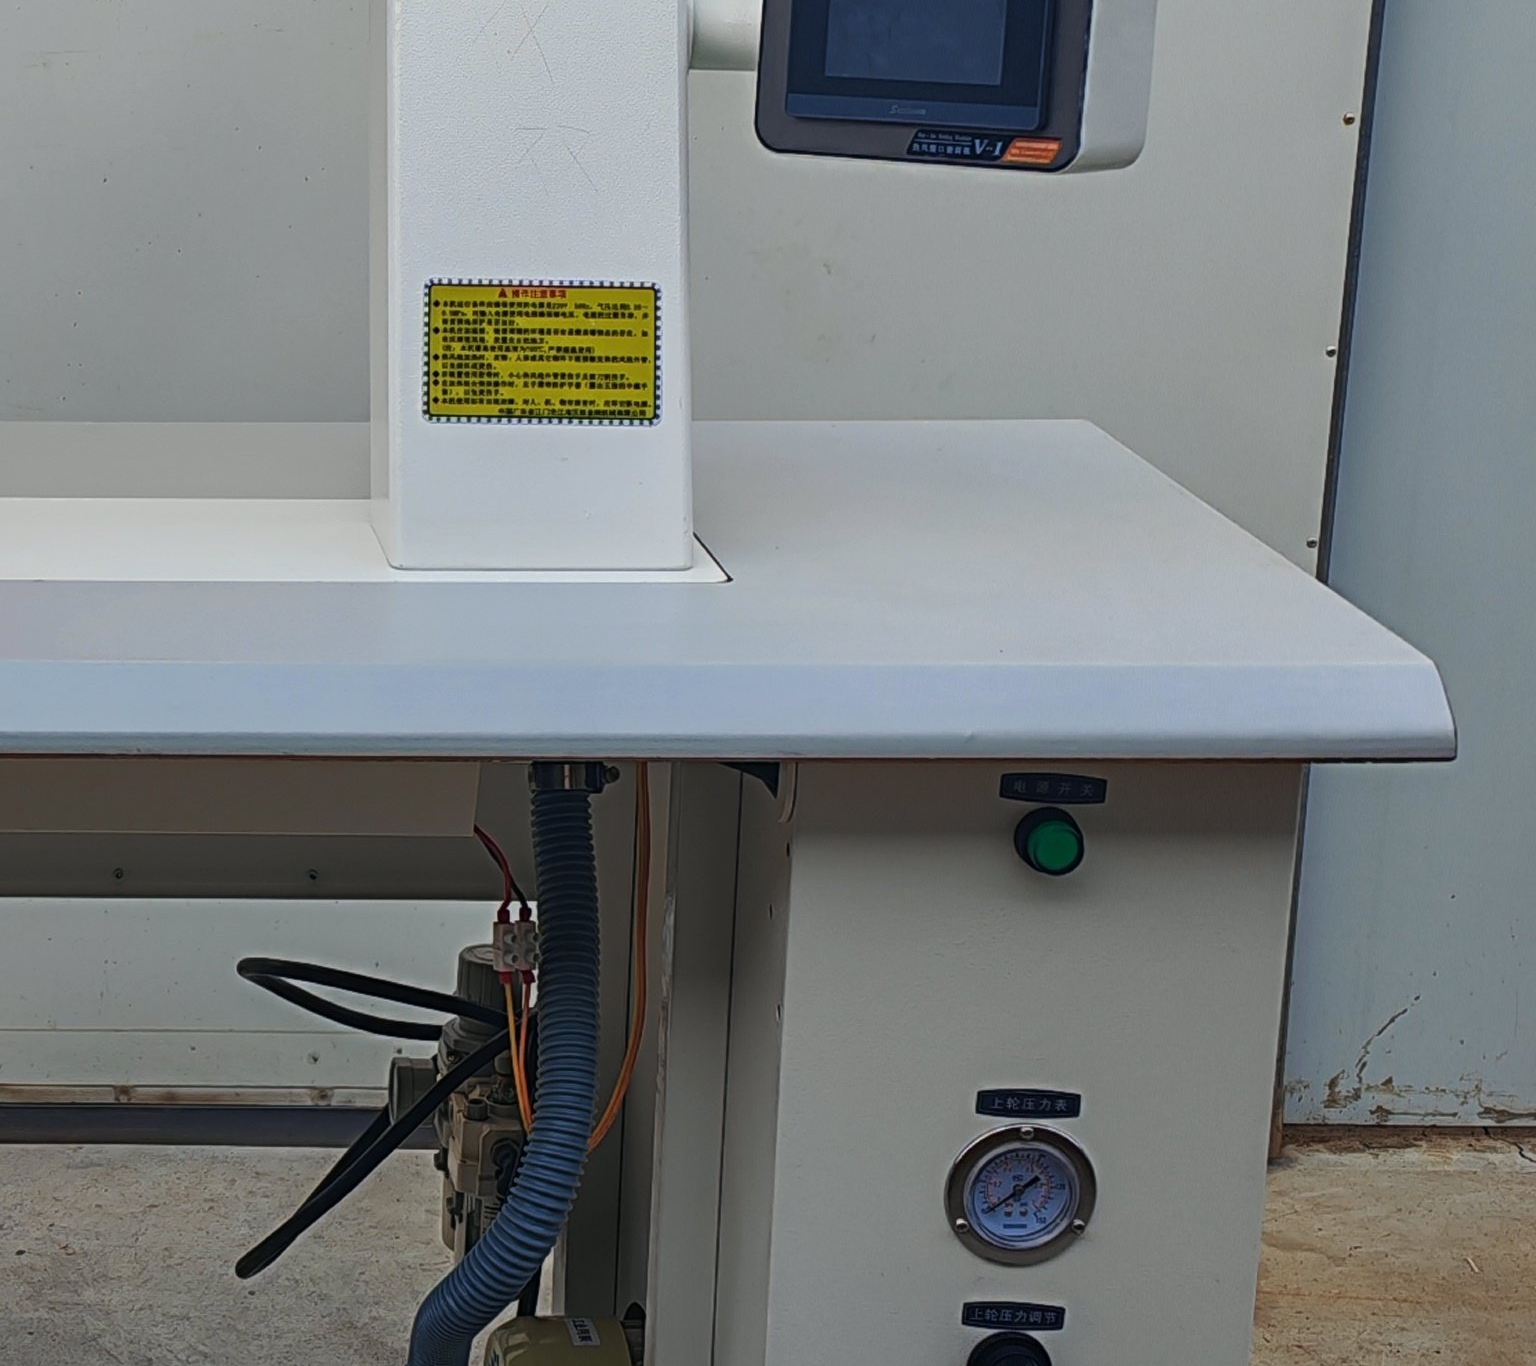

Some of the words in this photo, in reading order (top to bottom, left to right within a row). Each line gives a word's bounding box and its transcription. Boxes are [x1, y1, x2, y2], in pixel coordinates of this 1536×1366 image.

[990, 1097, 1068, 1112] 上轮压力表
